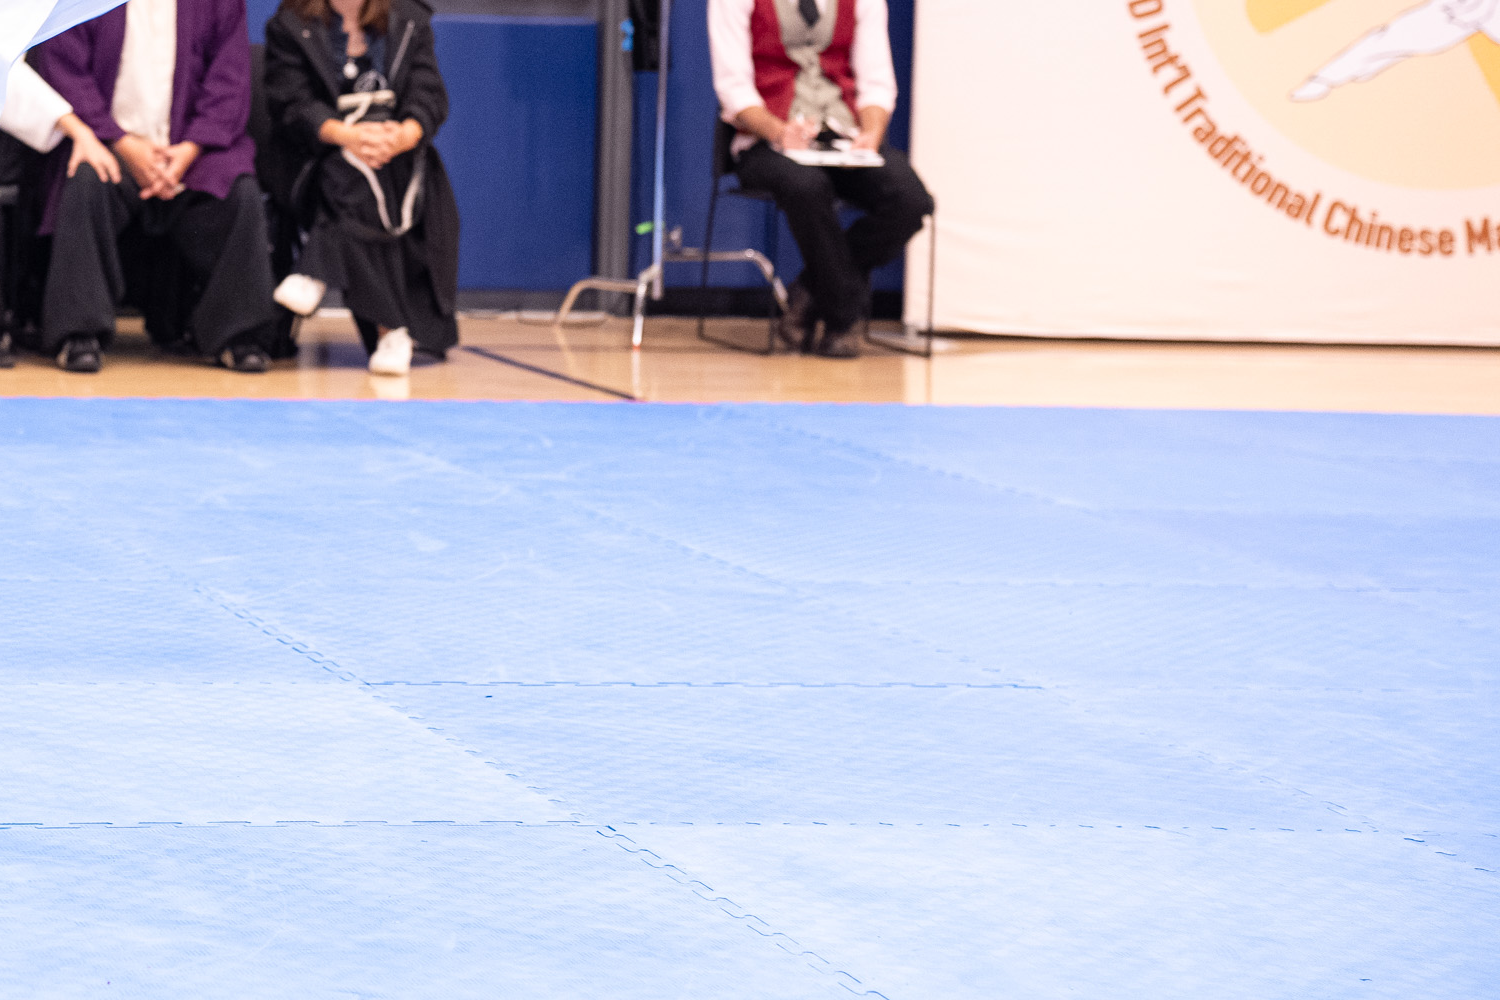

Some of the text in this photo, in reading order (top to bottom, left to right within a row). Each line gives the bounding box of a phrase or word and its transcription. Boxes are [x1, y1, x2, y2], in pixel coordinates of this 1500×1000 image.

[1174, 86, 1321, 227] Traditional
[1322, 200, 1455, 256] Chinese
[1464, 216, 1500, 254] M
